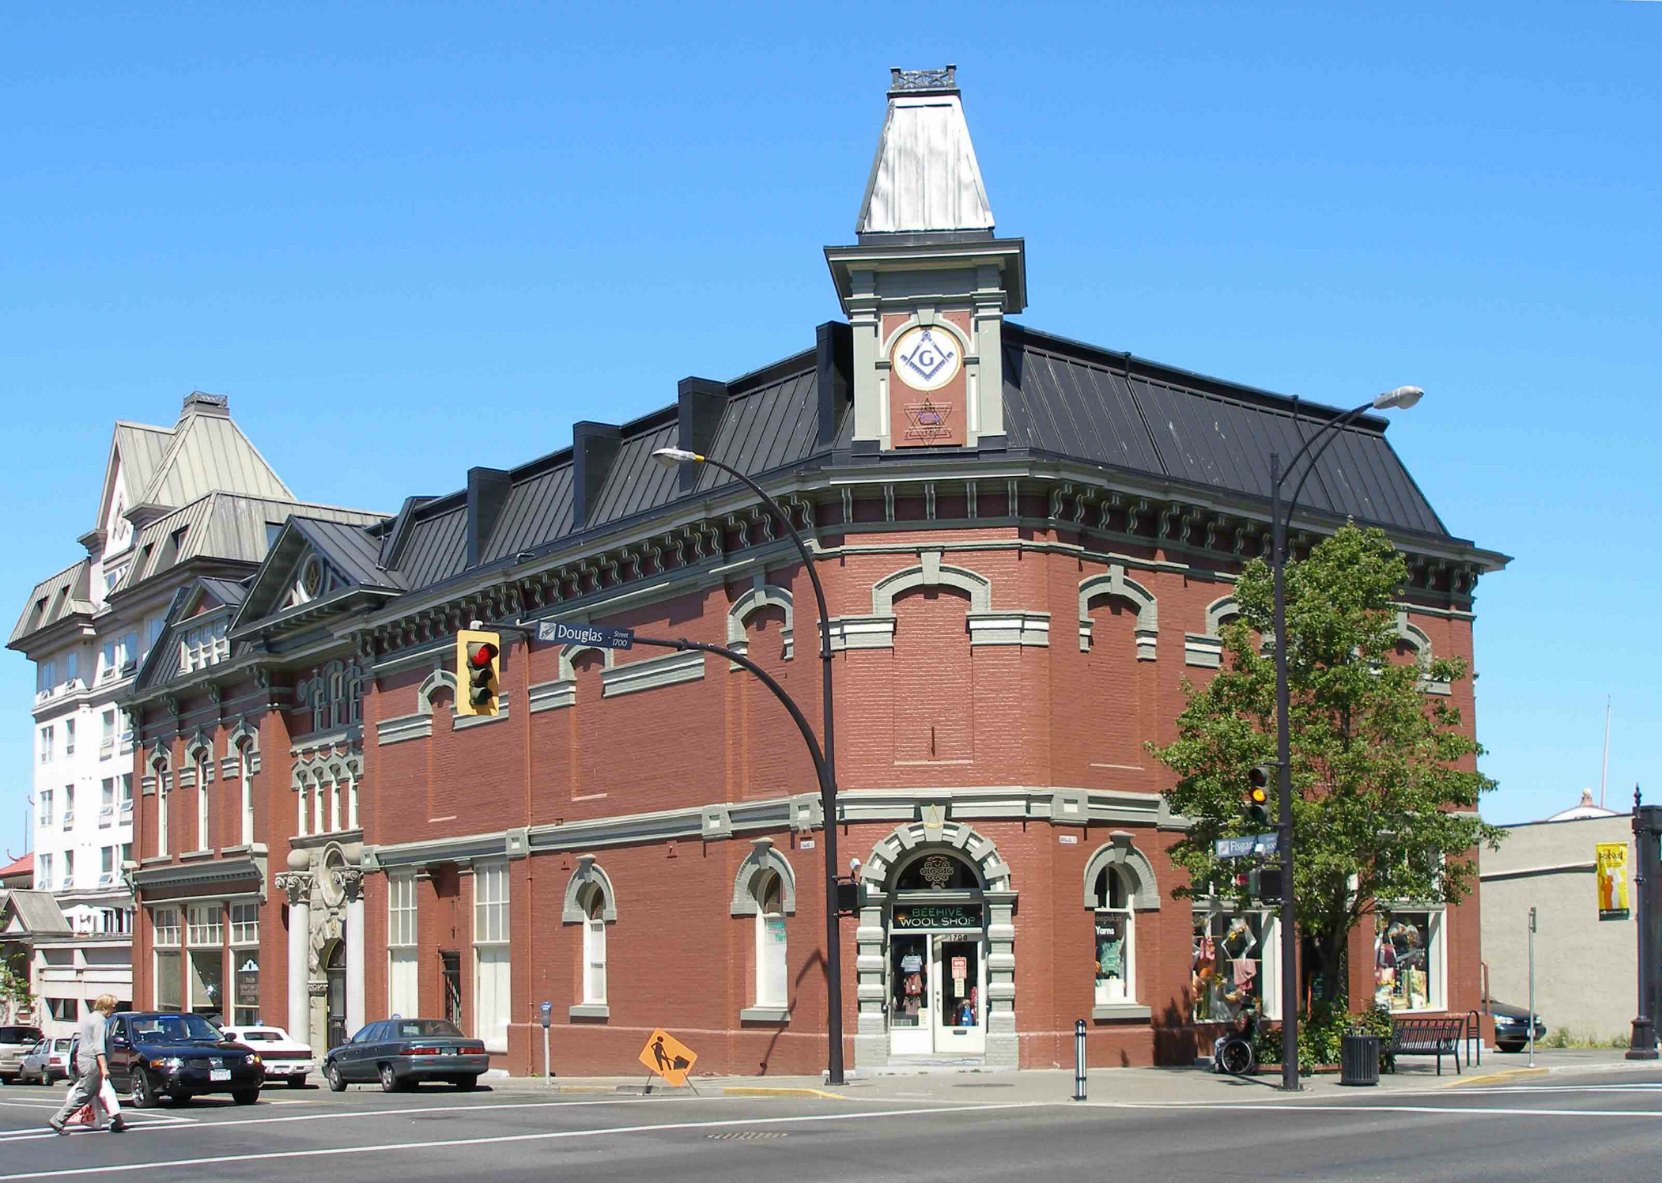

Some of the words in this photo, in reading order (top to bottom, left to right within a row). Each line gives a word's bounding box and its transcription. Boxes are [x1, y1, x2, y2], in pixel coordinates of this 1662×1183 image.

[919, 350, 934, 367] G
[558, 624, 603, 643] Douglas
[613, 630, 629, 638] Street
[612, 639, 628, 647] 1700
[912, 907, 963, 917] BEEHIVE
[900, 917, 938, 927] WOOL
[941, 916, 976, 927] SHOP
[1095, 925, 1115, 935] Yarns
